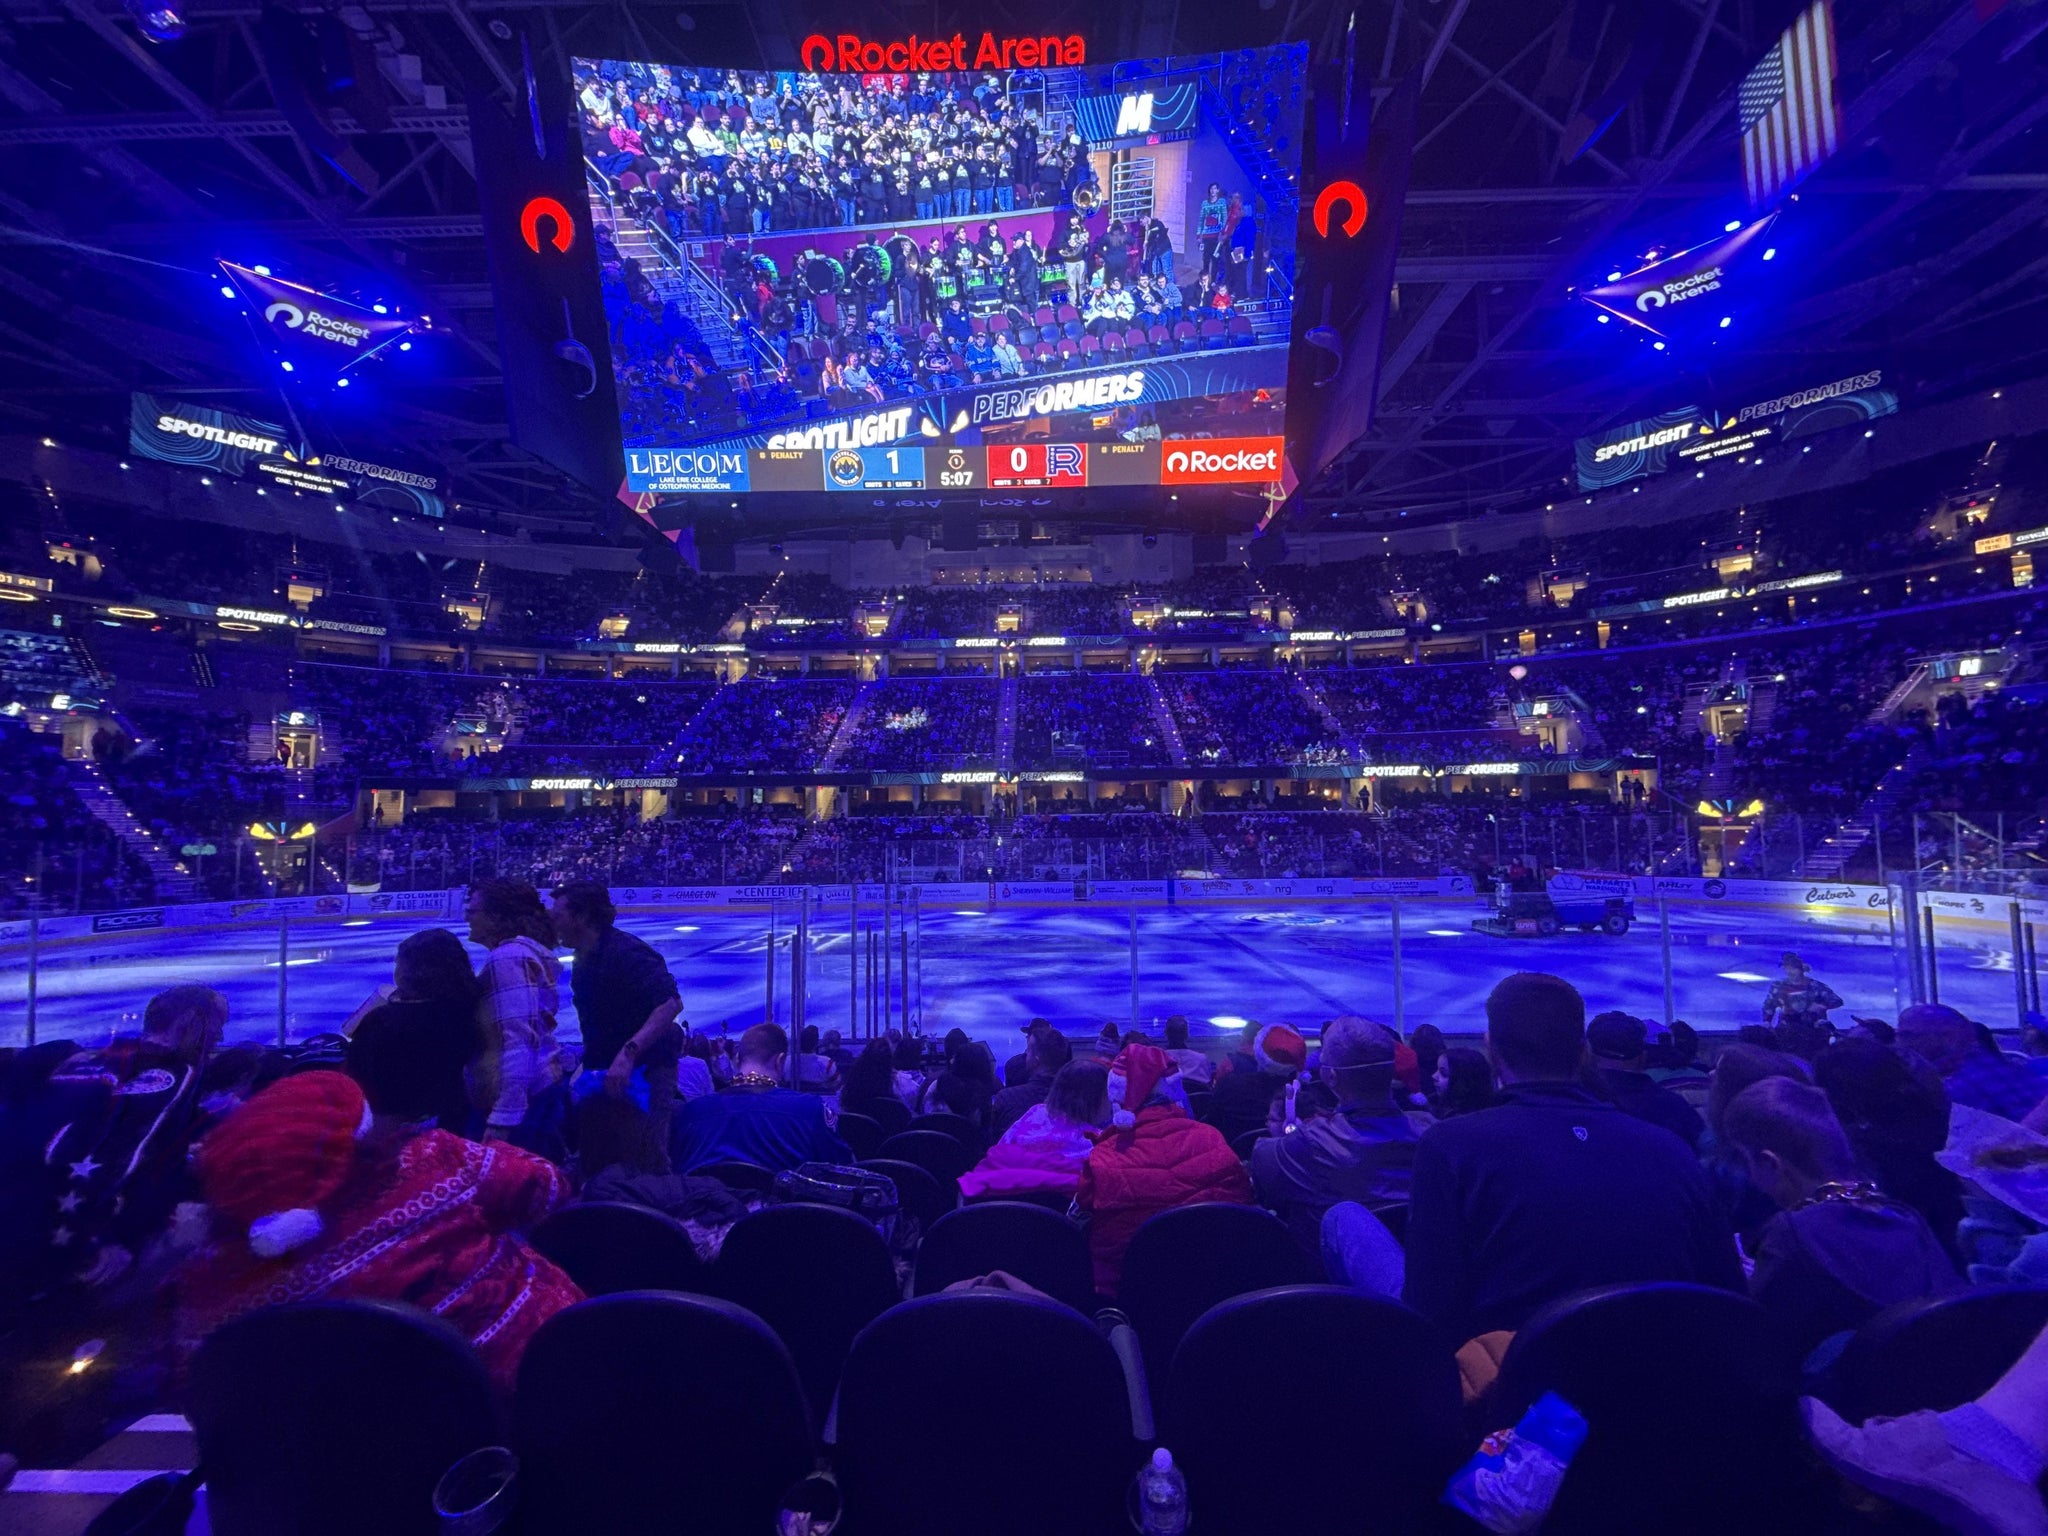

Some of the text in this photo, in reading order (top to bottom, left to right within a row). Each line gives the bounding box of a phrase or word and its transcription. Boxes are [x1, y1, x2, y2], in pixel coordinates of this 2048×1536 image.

[837, 32, 1086, 72] Rocket Arena
[1116, 93, 1153, 135] M
[1663, 266, 1724, 295] Rocket
[1670, 280, 1721, 304] Arena
[307, 311, 370, 339] Rocket
[302, 323, 358, 347] Arena
[974, 372, 1144, 423] PERFORMERS
[1595, 370, 1882, 462] SPOTLIGHT PERFORMERS
[157, 415, 437, 490] SPOTLIGHT PERFORMERS
[770, 451, 803, 460] PENALTY
[1112, 445, 1145, 453] PENALTY
[630, 452, 744, 475] LECOM
[886, 449, 899, 475] 1
[1009, 447, 1028, 473] 0
[1190, 449, 1277, 472] Rocket
[940, 471, 973, 486] 5:07
[18, 578, 36, 587] PM
[1664, 570, 1842, 607] SPOTLIGHT PERFORMERS
[216, 607, 387, 635] SPOTLIGHT PERFORMERS
[1290, 628, 1406, 640] SPOTLIGHT PERFORMERS
[634, 643, 680, 652] SPOTLIGHT
[955, 638, 999, 647] SPOTLIGHT
[52, 694, 71, 710] E
[941, 772, 997, 783] SPOTLIGHT
[1363, 763, 1519, 777] SPOTLIGHT PERFORMERS
[530, 778, 678, 790] SPOTLIGHT PERFORMERS
[397, 892, 446, 900] COLUMBU
[744, 887, 786, 897] CENTER
[1275, 886, 1291, 895] nrg
[1317, 885, 1333, 894] nrg
[1806, 887, 1856, 903] Culver's
